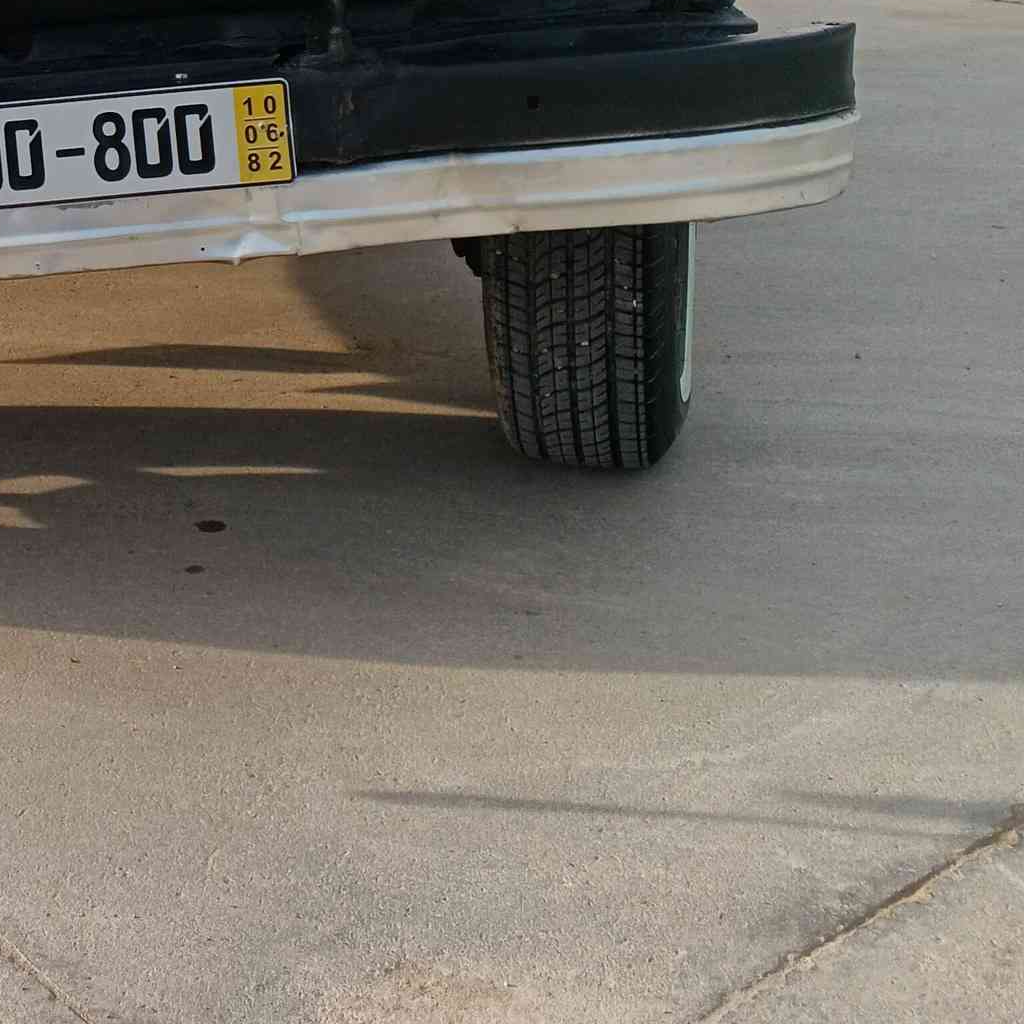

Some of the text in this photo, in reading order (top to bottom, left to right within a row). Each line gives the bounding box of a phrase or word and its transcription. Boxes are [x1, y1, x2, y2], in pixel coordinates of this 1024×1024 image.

[242, 95, 277, 116] 10
[244, 123, 279, 144] 06
[247, 150, 283, 172] 82
